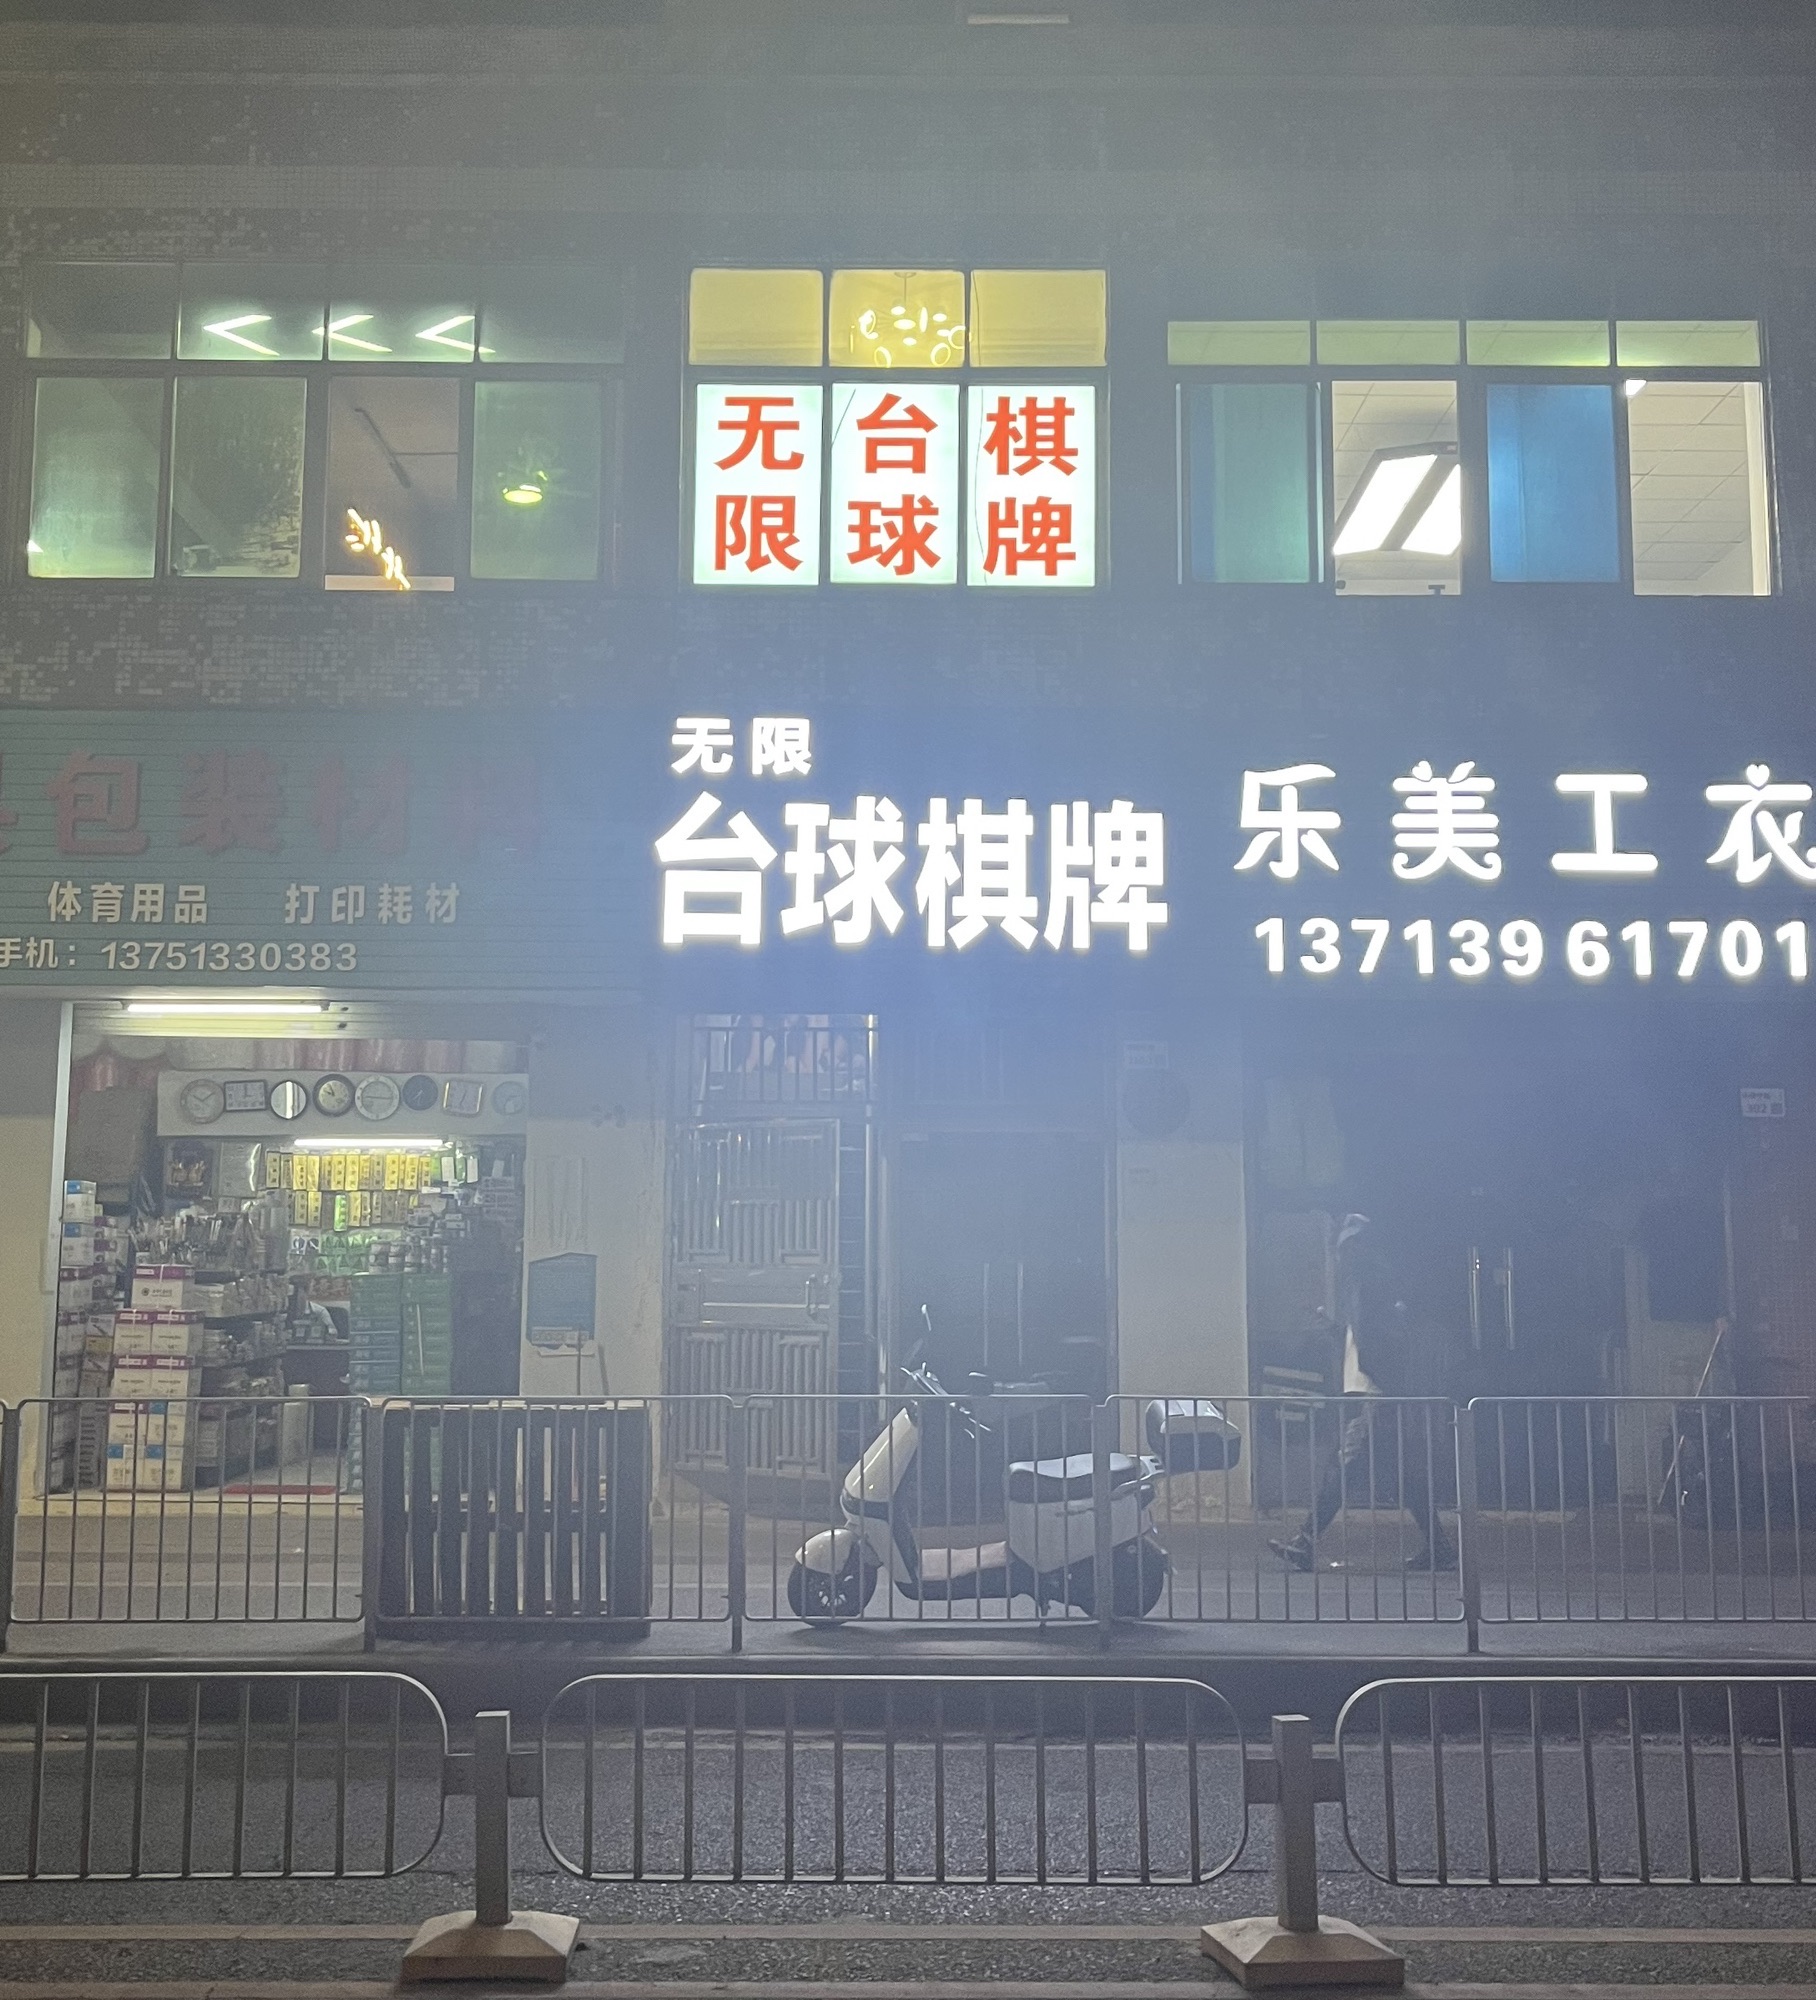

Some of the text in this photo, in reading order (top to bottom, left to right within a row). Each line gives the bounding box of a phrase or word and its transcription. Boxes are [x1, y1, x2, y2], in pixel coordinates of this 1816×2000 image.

[670, 716, 813, 776] 无限
[1233, 760, 1816, 884] 乐美工衣
[654, 790, 1168, 952] 台球棋牌
[47, 880, 461, 925] 体育用品 打印耗材
[100, 940, 358, 972] 13751330383
[1254, 916, 1807, 978] 13713961701
